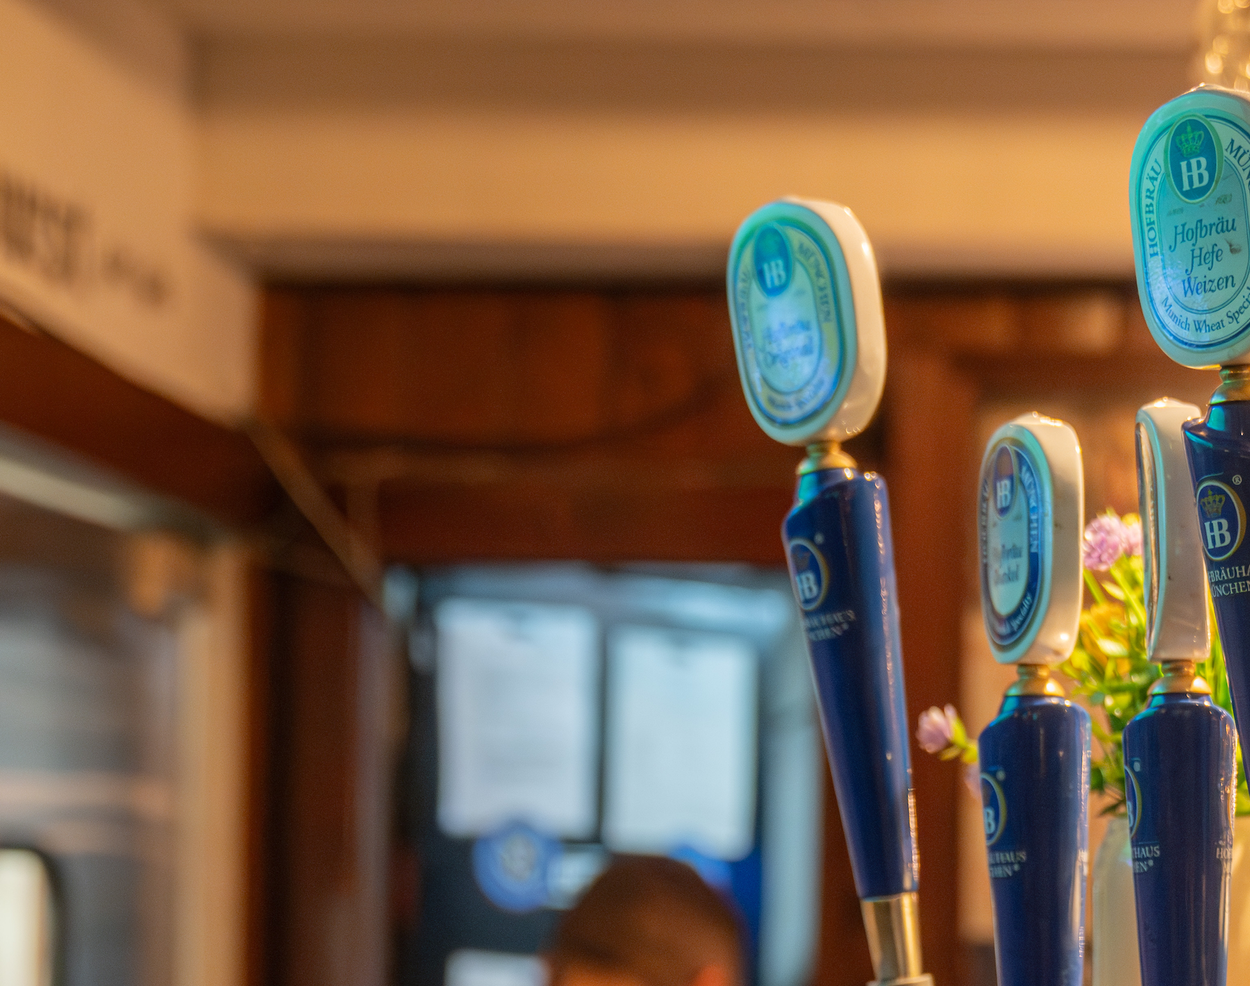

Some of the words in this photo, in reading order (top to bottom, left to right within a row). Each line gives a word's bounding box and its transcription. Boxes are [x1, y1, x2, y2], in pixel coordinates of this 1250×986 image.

[1180, 157, 1210, 192] HB
[1144, 158, 1164, 259] HOFBRÄU
[1169, 216, 1237, 253] Hofbräu
[1185, 243, 1224, 276] Hefe
[1181, 275, 1237, 298] Weizen
[1161, 296, 1191, 332] Munich
[1193, 318, 1226, 334] Wheat
[1204, 518, 1232, 550] HB
